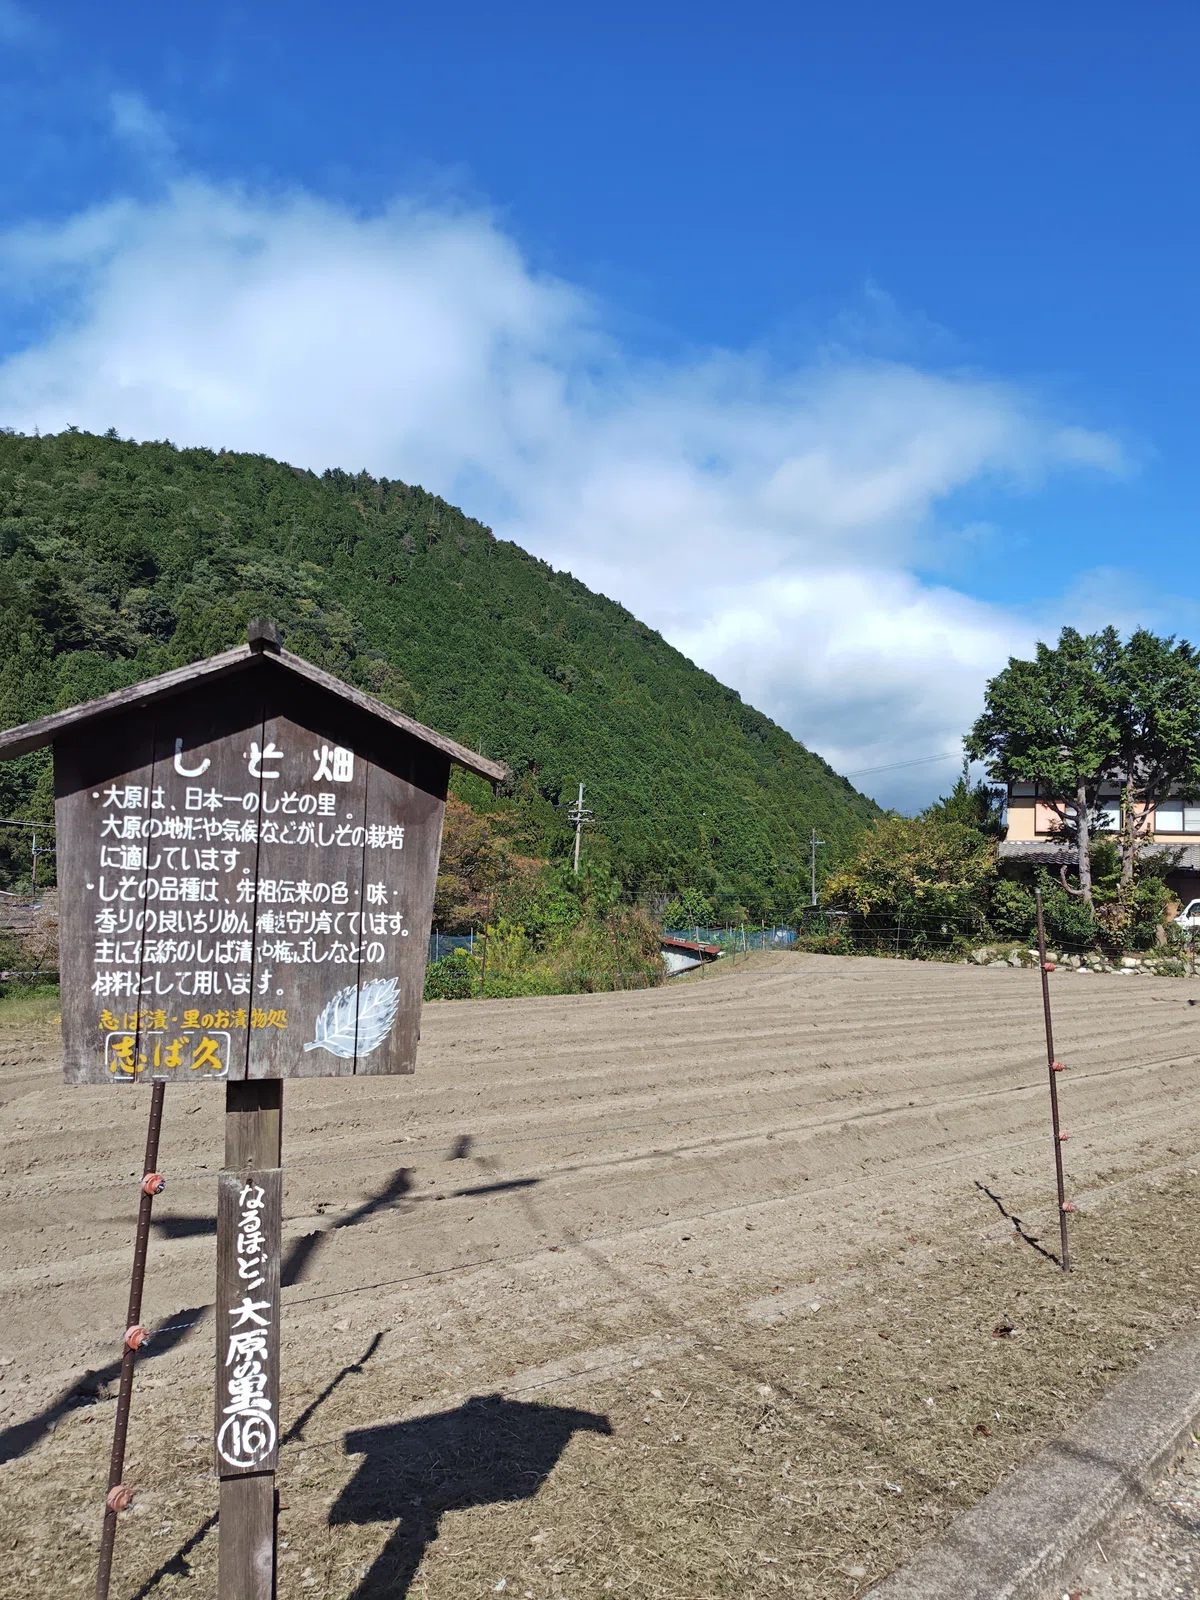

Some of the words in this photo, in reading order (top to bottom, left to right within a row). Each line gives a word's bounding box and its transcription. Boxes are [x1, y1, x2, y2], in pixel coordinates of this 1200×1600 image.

[174, 738, 355, 783] しそ畑
[99, 845, 251, 875] に適しています。
[93, 937, 385, 965] 主に伝統のしば漬や梅ぼしなどの
[91, 970, 285, 997] 材料として用います。
[109, 1036, 223, 1074] 志ば久
